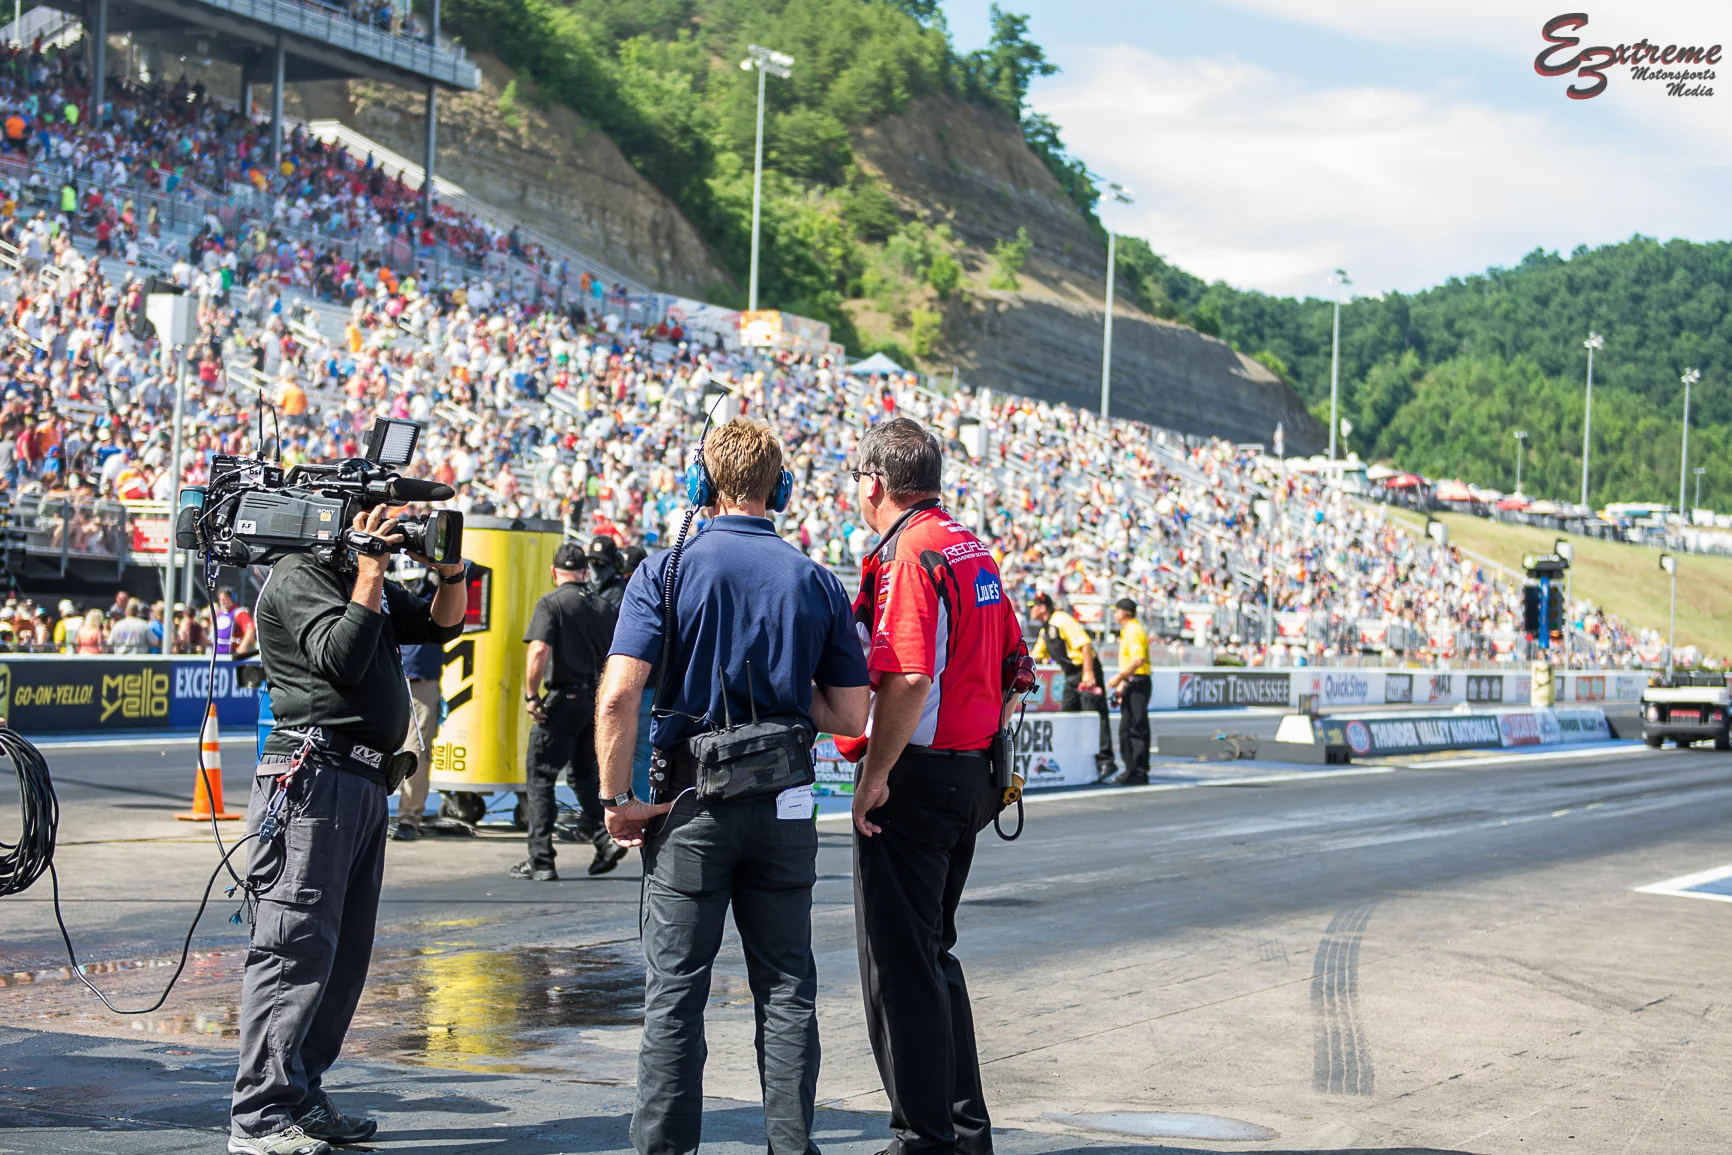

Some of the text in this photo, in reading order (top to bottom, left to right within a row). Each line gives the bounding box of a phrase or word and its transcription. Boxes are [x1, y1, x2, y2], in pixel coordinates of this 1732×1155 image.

[15, 684, 93, 706] GO-ON-YELLO!
[176, 667, 229, 698] EXCEED
[1325, 675, 1367, 703] QuickStop
